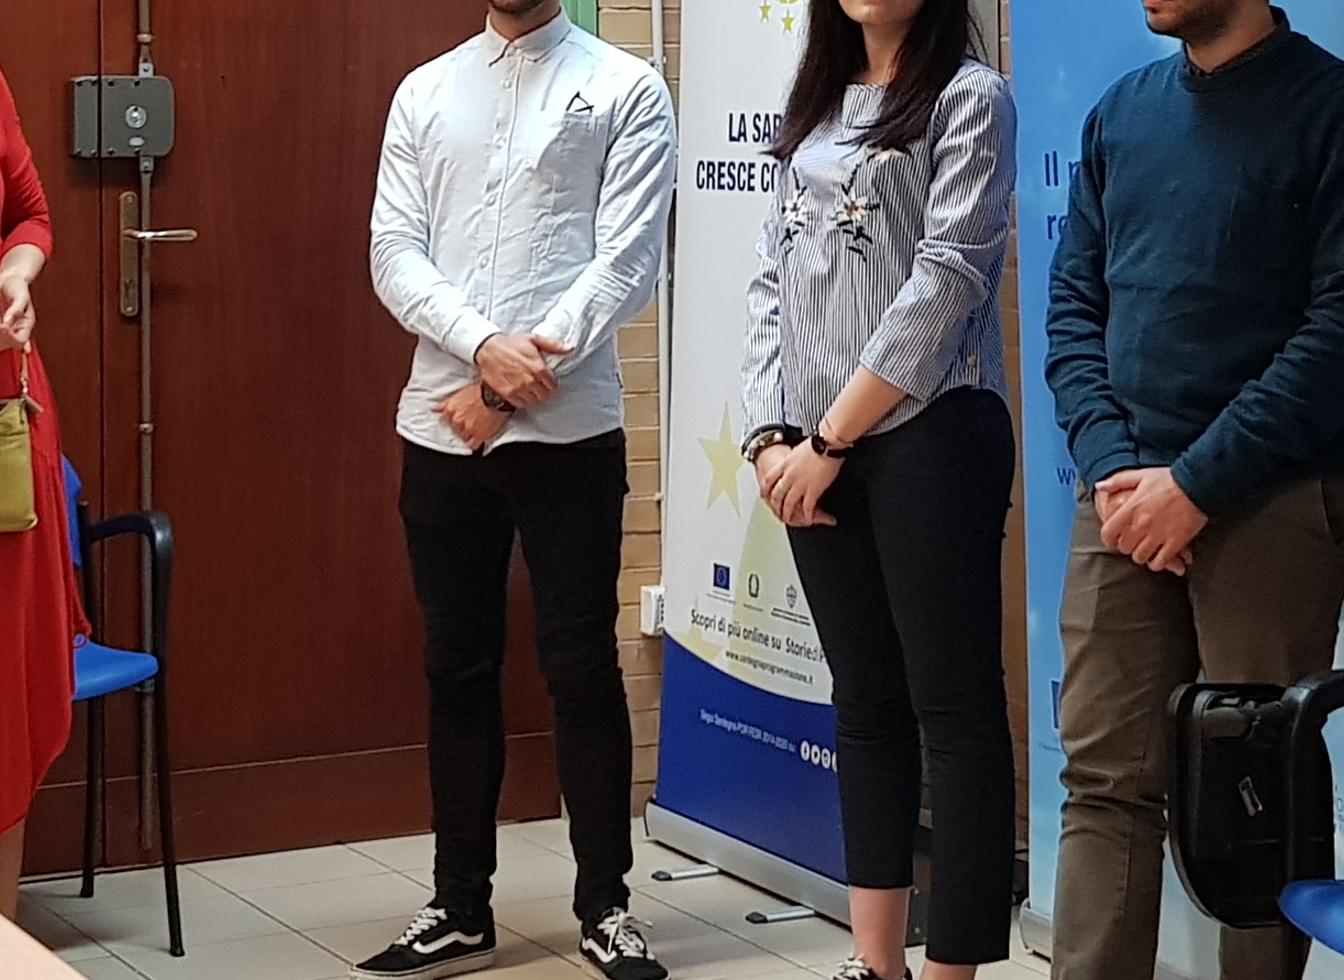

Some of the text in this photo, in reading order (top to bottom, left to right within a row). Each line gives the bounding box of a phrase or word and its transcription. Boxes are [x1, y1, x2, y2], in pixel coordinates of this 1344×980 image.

[728, 112, 748, 143] LA
[696, 159, 756, 192] CRESCE
[690, 608, 716, 632] Scopri
[717, 616, 726, 633] di
[727, 620, 742, 638] più
[742, 626, 770, 648] online
[770, 635, 782, 651] su
